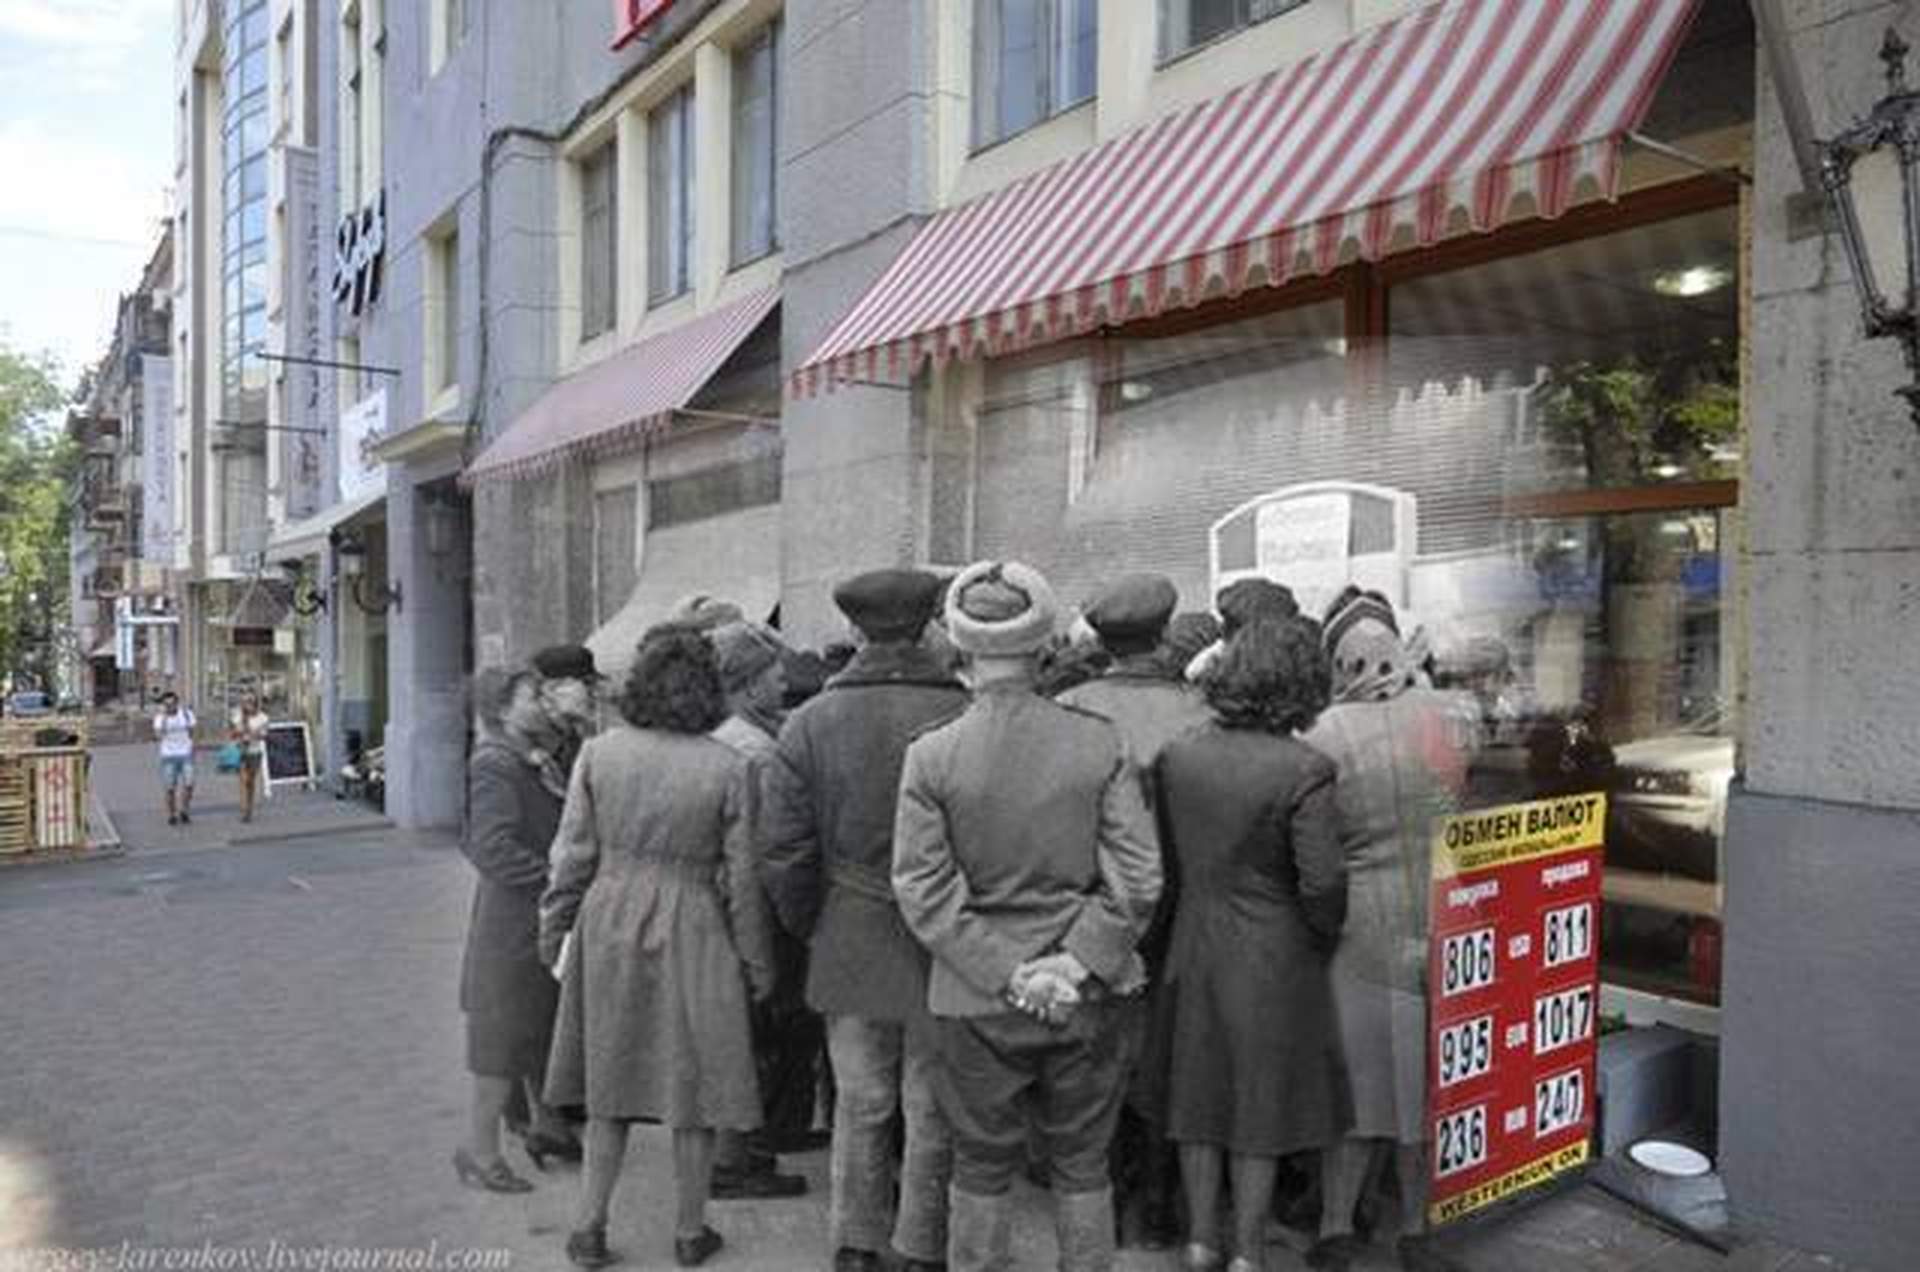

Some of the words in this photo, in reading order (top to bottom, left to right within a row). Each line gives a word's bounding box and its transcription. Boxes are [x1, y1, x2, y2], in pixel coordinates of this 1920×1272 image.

[1446, 811, 1522, 848] ОБМЕН
[1527, 799, 1597, 834] ВАЛЮТ
[1446, 932, 1490, 991] 806
[1548, 908, 1588, 962] 811
[1539, 991, 1590, 1048] 1017
[1443, 1020, 1488, 1081] 995
[1539, 1075, 1579, 1130] 247
[1439, 1109, 1482, 1170] 236
